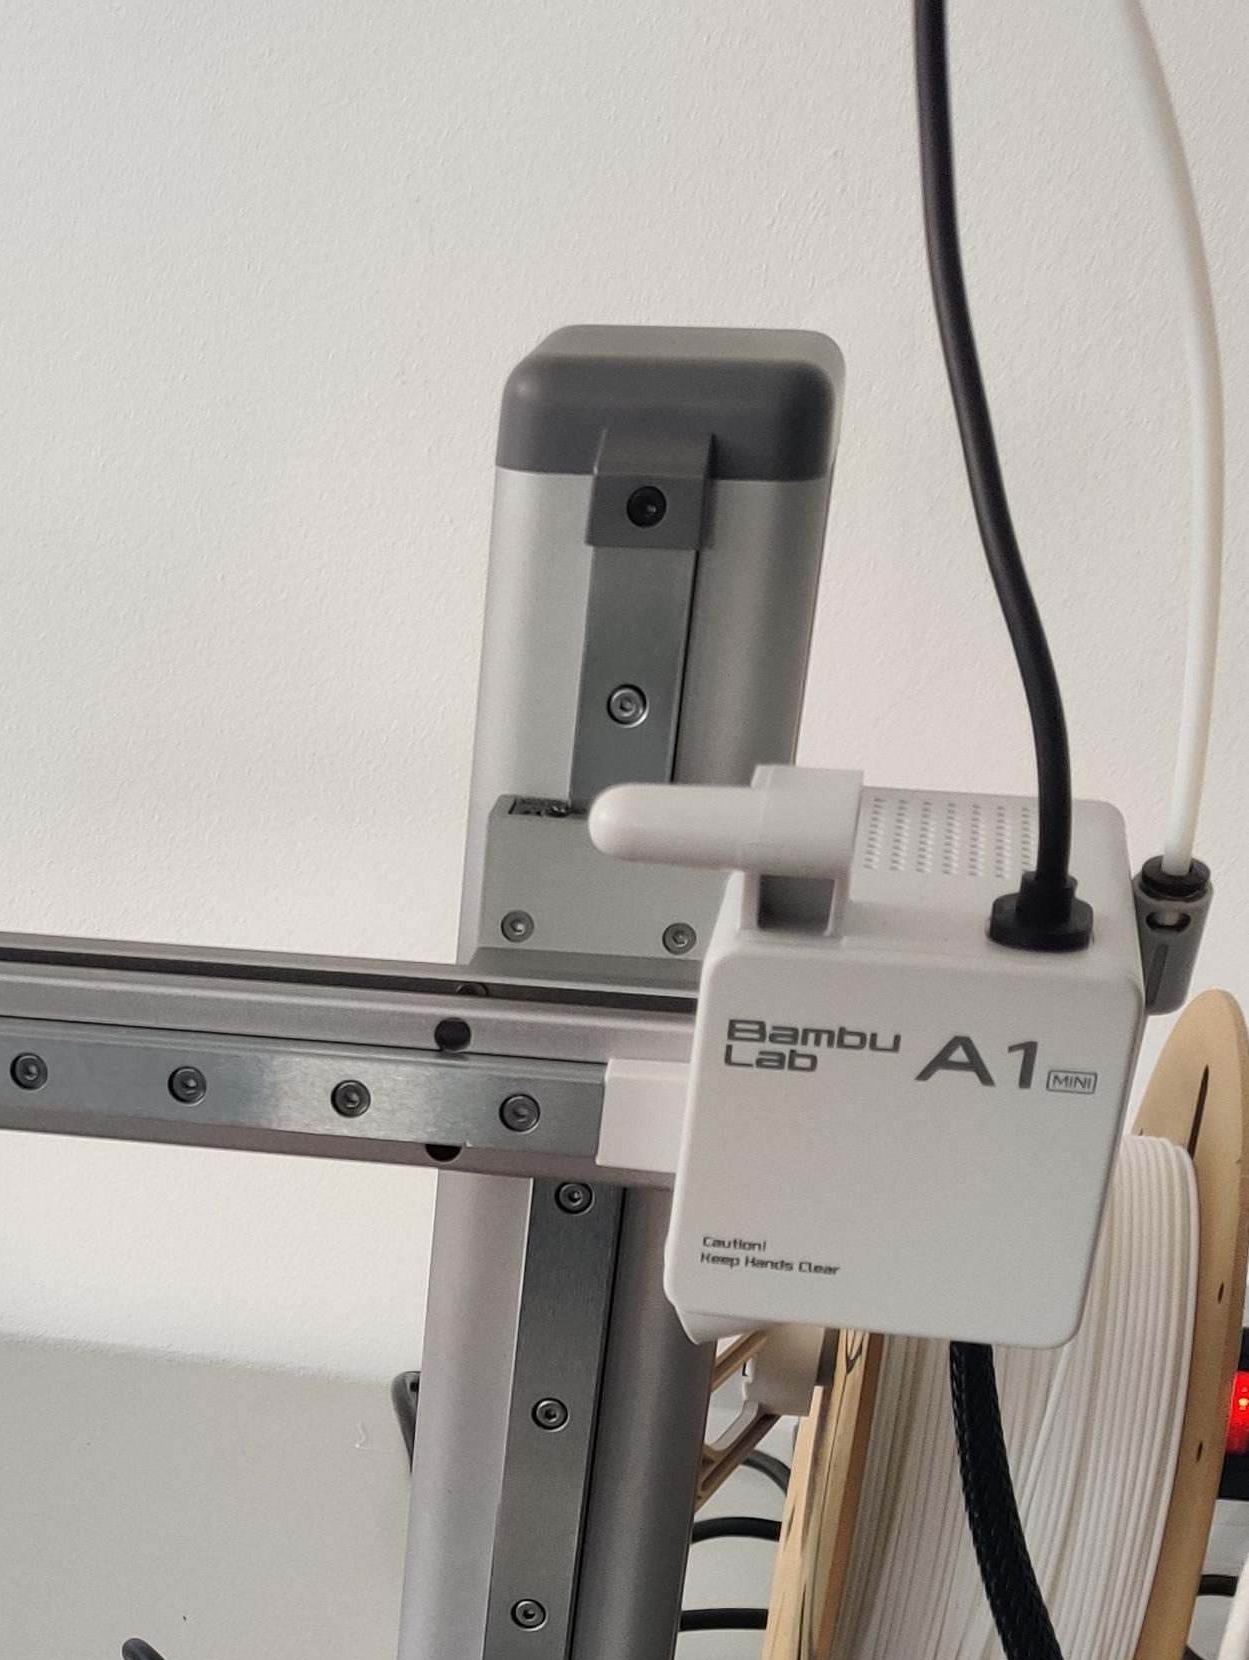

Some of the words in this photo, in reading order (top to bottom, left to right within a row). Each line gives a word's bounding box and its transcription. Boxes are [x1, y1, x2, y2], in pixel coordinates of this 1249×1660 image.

[727, 1019, 901, 1052] Bambu
[724, 1044, 818, 1072] Lab
[914, 1035, 1038, 1089] A1
[1052, 1075, 1093, 1091] MINI
[702, 1236, 767, 1252] Caution!
[700, 1252, 740, 1269] Keep
[745, 1255, 794, 1272] Hands
[798, 1260, 841, 1275] Clear
